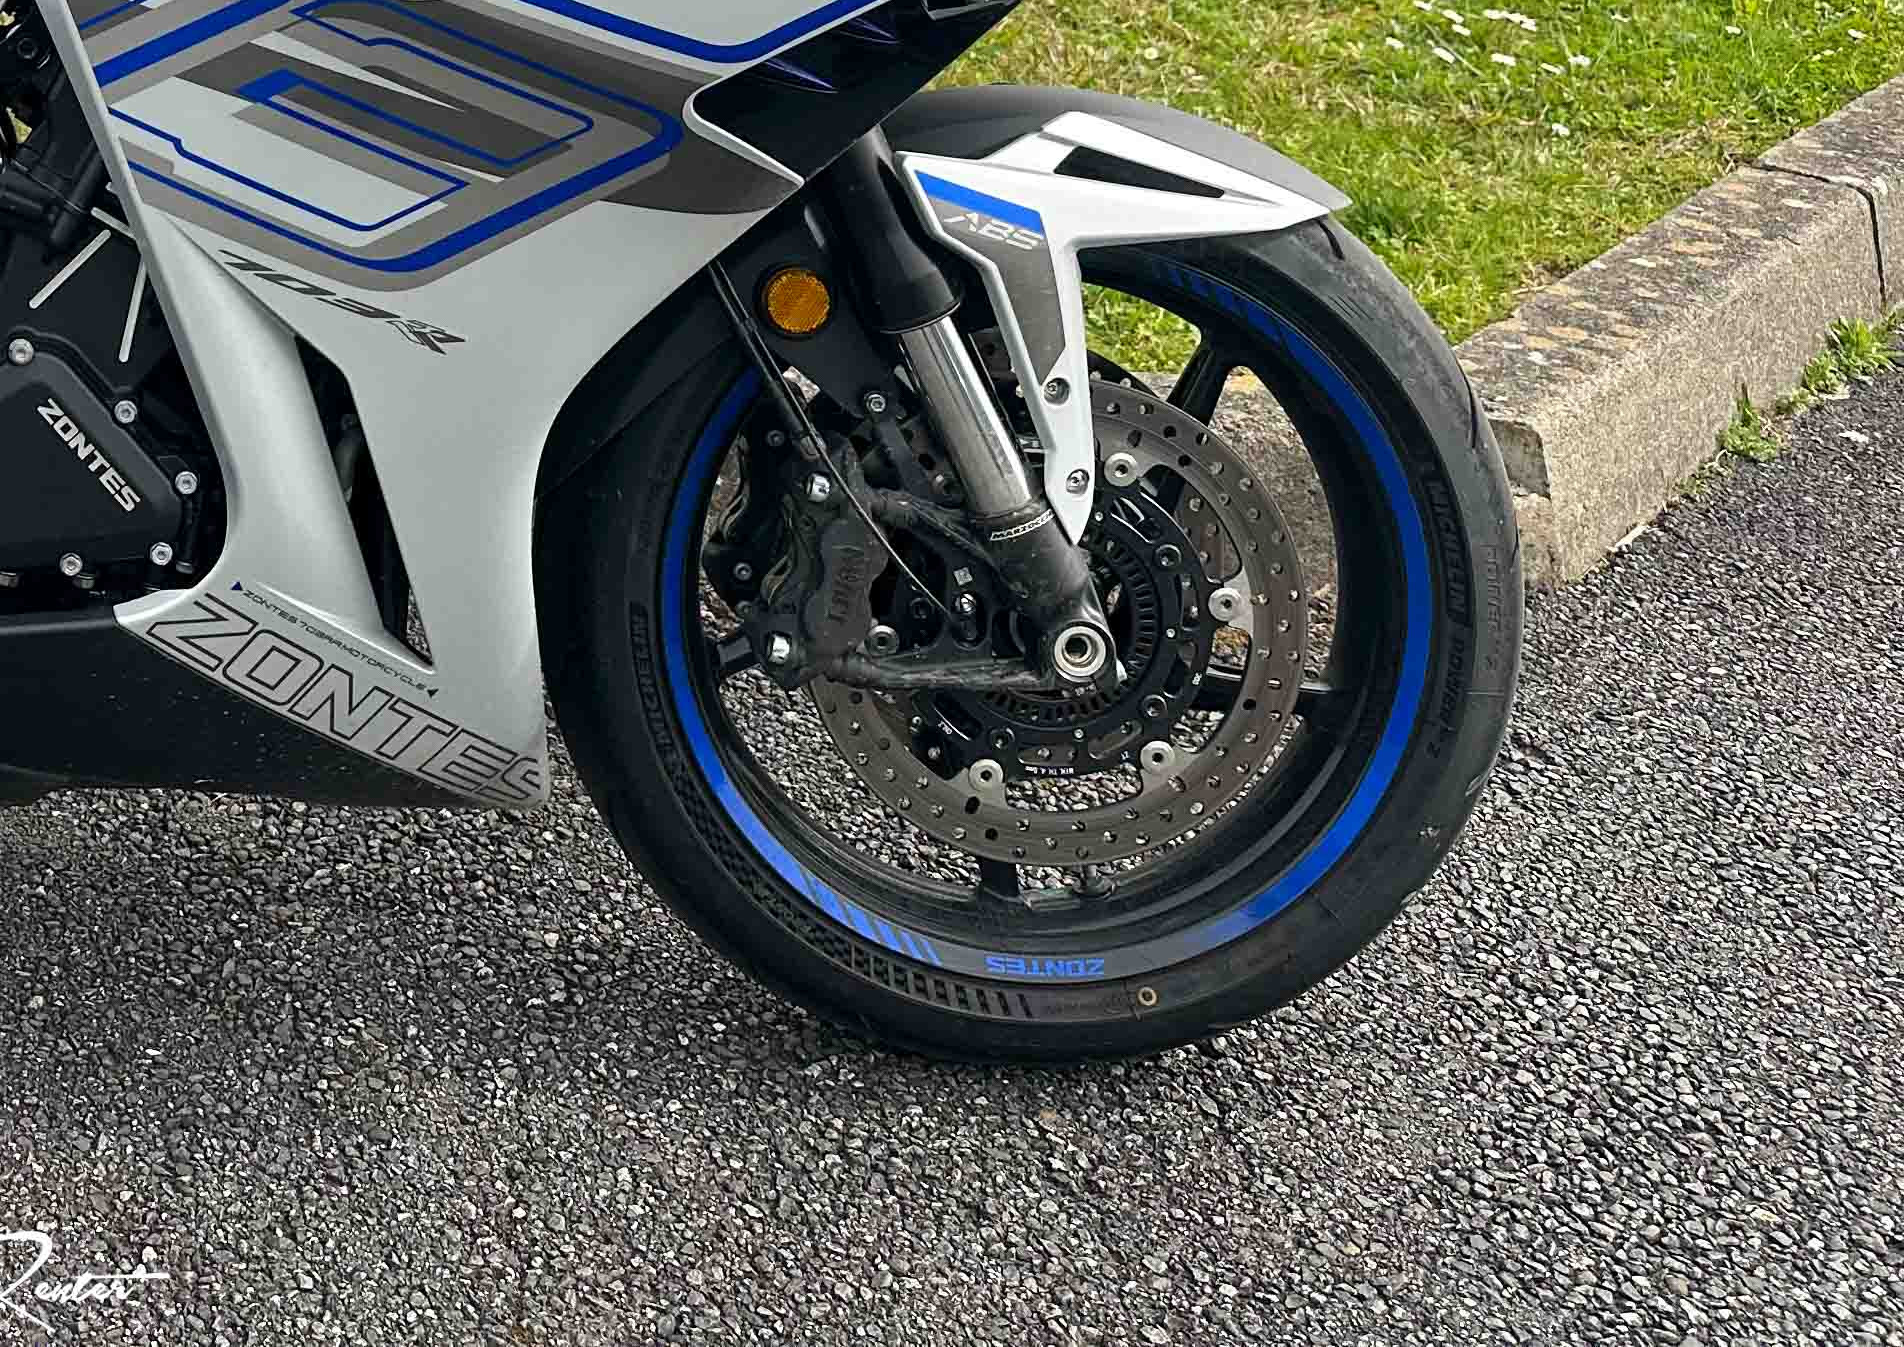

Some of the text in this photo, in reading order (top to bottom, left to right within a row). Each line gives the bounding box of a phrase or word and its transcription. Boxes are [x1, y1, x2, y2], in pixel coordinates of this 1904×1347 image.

[943, 213, 1045, 251] ABS
[36, 397, 141, 512] ZONTES
[242, 589, 297, 625] ZONTES
[145, 593, 542, 803] ZONTES
[983, 955, 1106, 978] ZONTES
